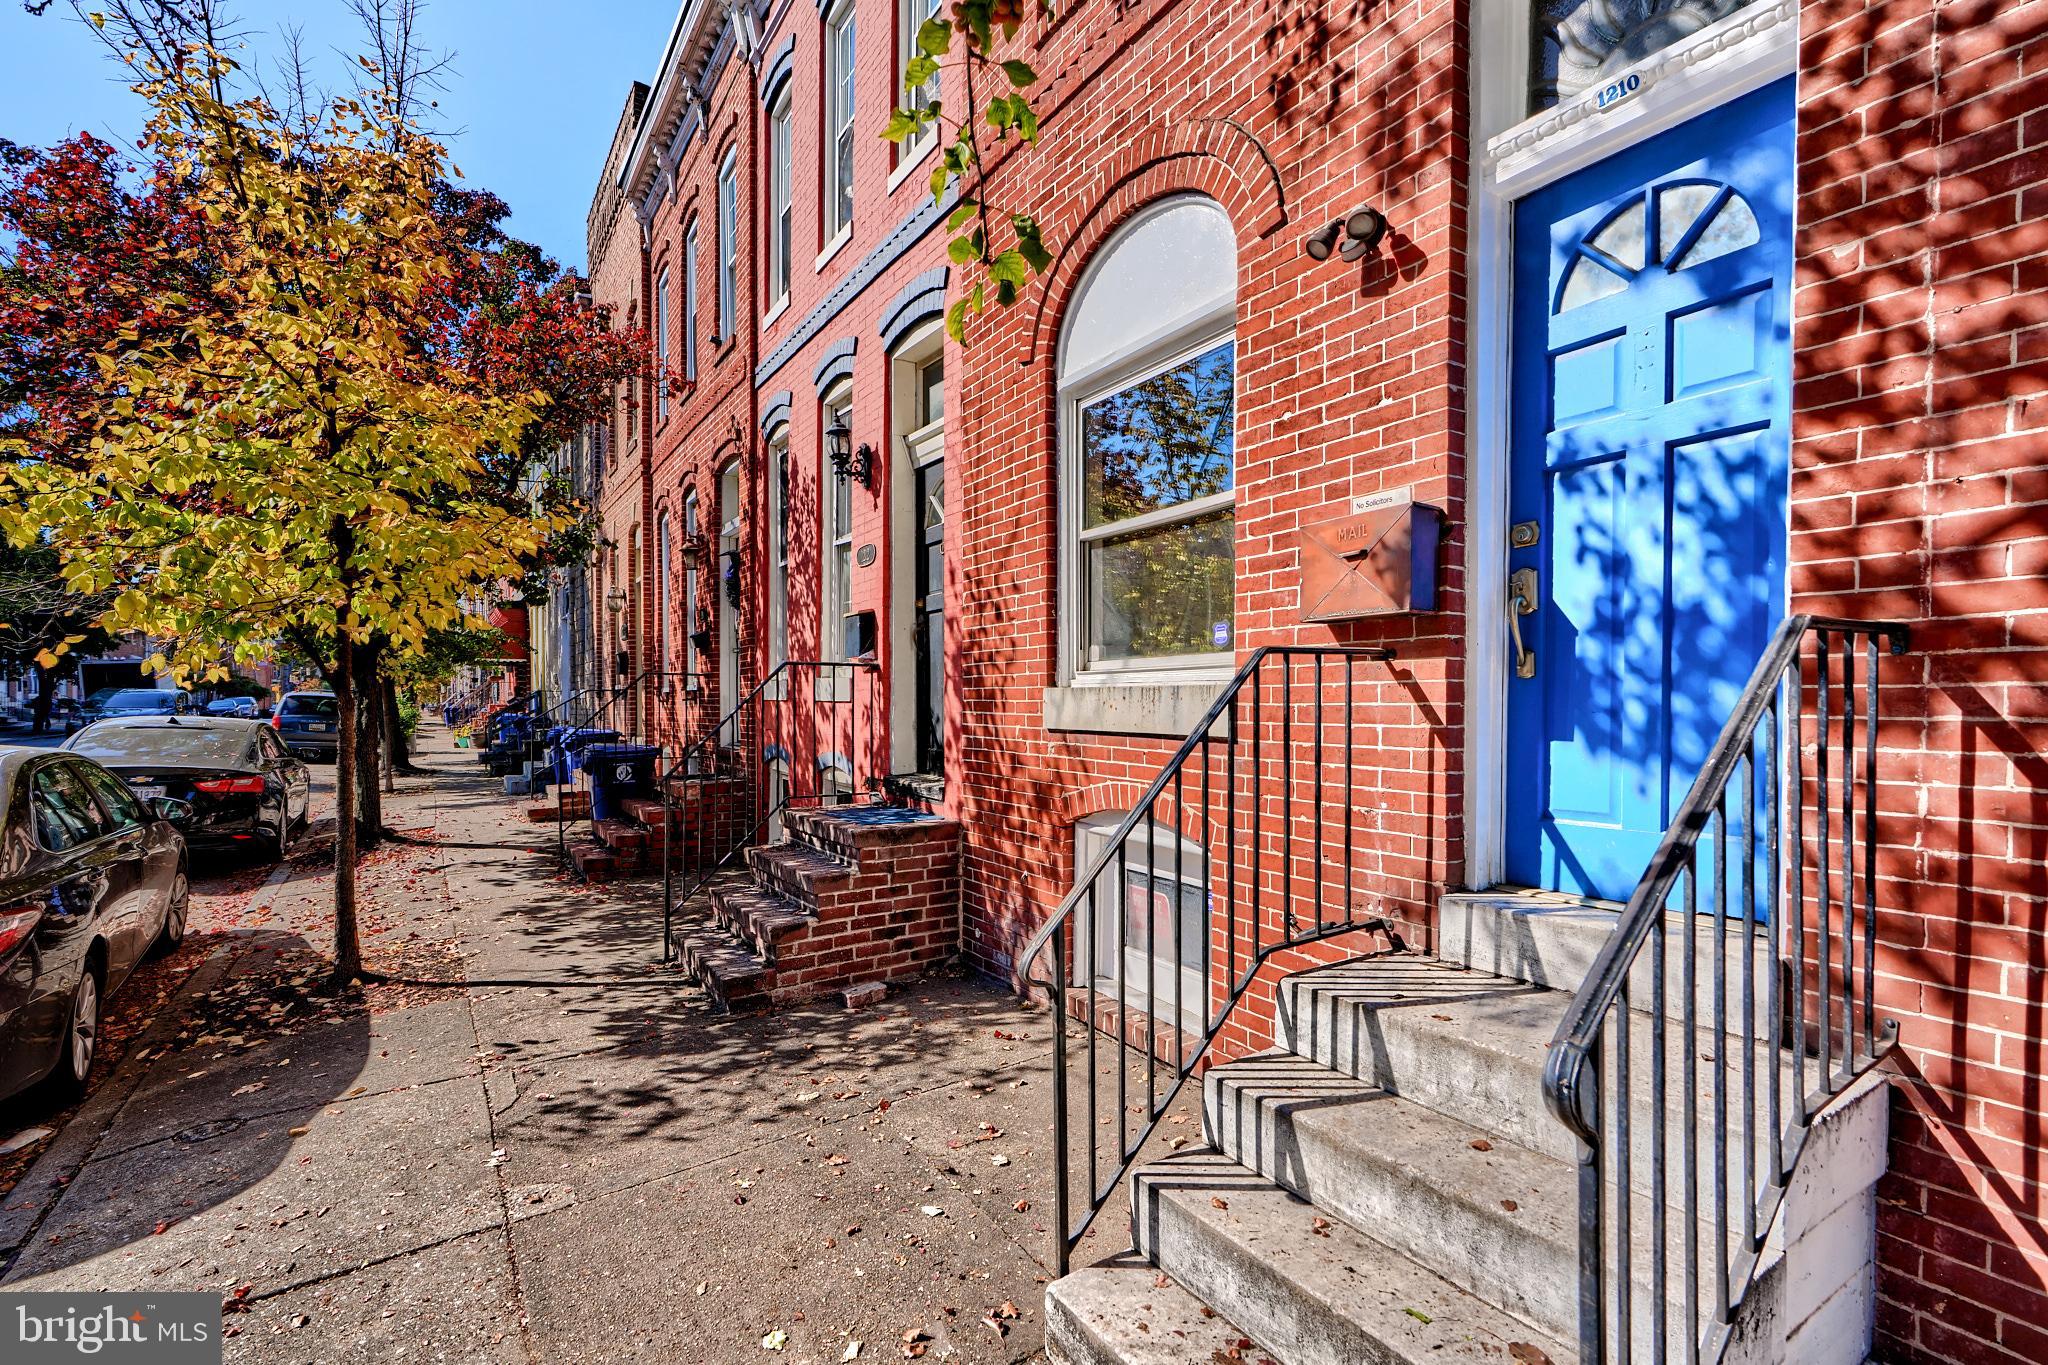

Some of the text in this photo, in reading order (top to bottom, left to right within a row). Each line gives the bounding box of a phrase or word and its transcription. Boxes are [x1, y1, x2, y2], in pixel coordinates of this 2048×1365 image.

[1598, 74, 1640, 108] 1210
[1365, 496, 1393, 508] Solicitors
[1337, 523, 1368, 542] MAIL
